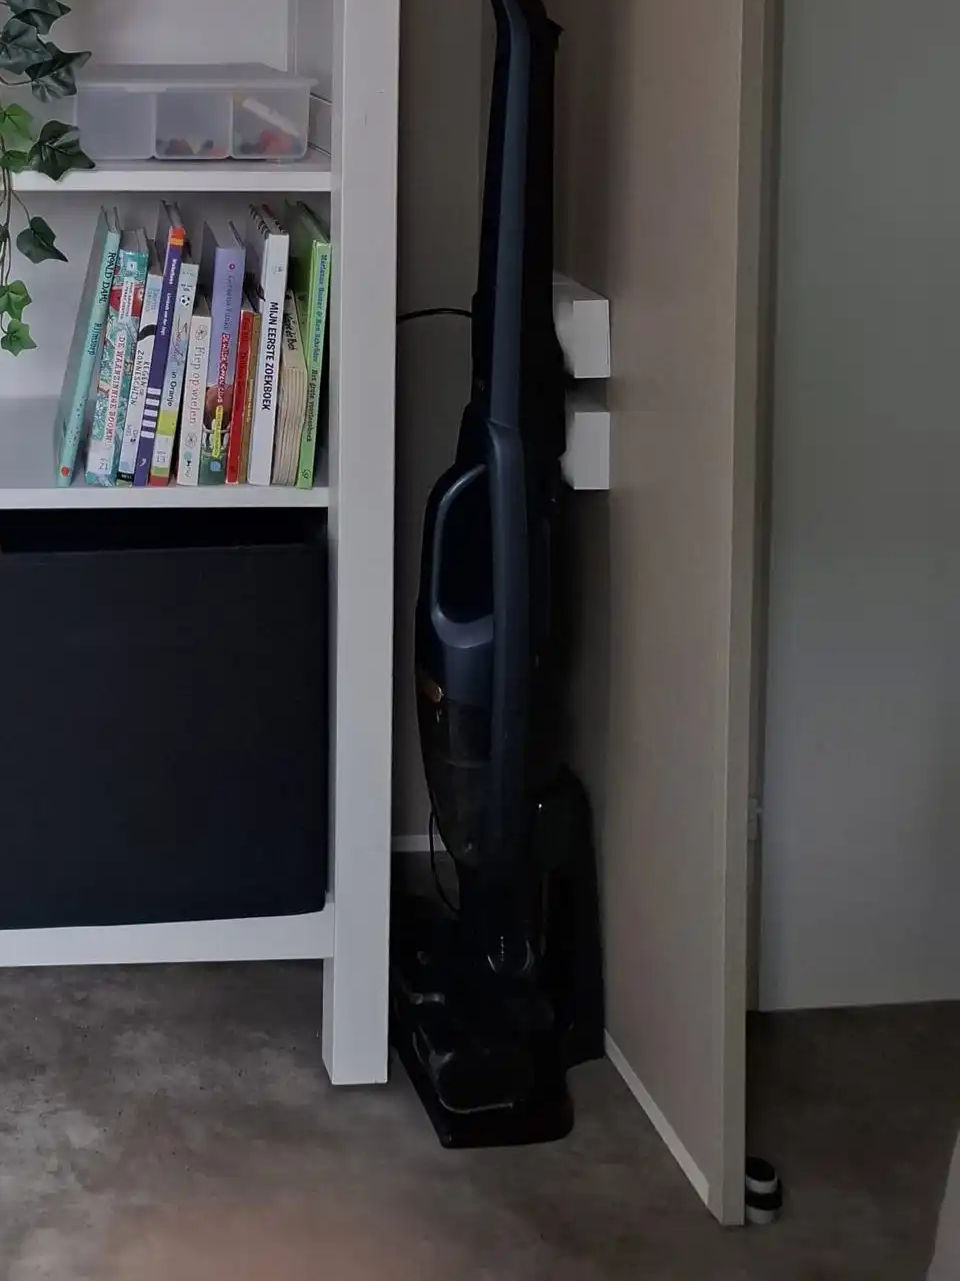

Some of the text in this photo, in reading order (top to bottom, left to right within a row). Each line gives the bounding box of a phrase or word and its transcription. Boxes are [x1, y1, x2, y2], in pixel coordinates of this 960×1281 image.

[99, 252, 116, 304] ROALD DAHL
[132, 350, 145, 406] ZONNESCHIJN
[262, 302, 279, 411] MIJN EERSTE ZOEKBOEK
[166, 371, 178, 407] in Oranje
[189, 346, 206, 425] Fiep op wielen
